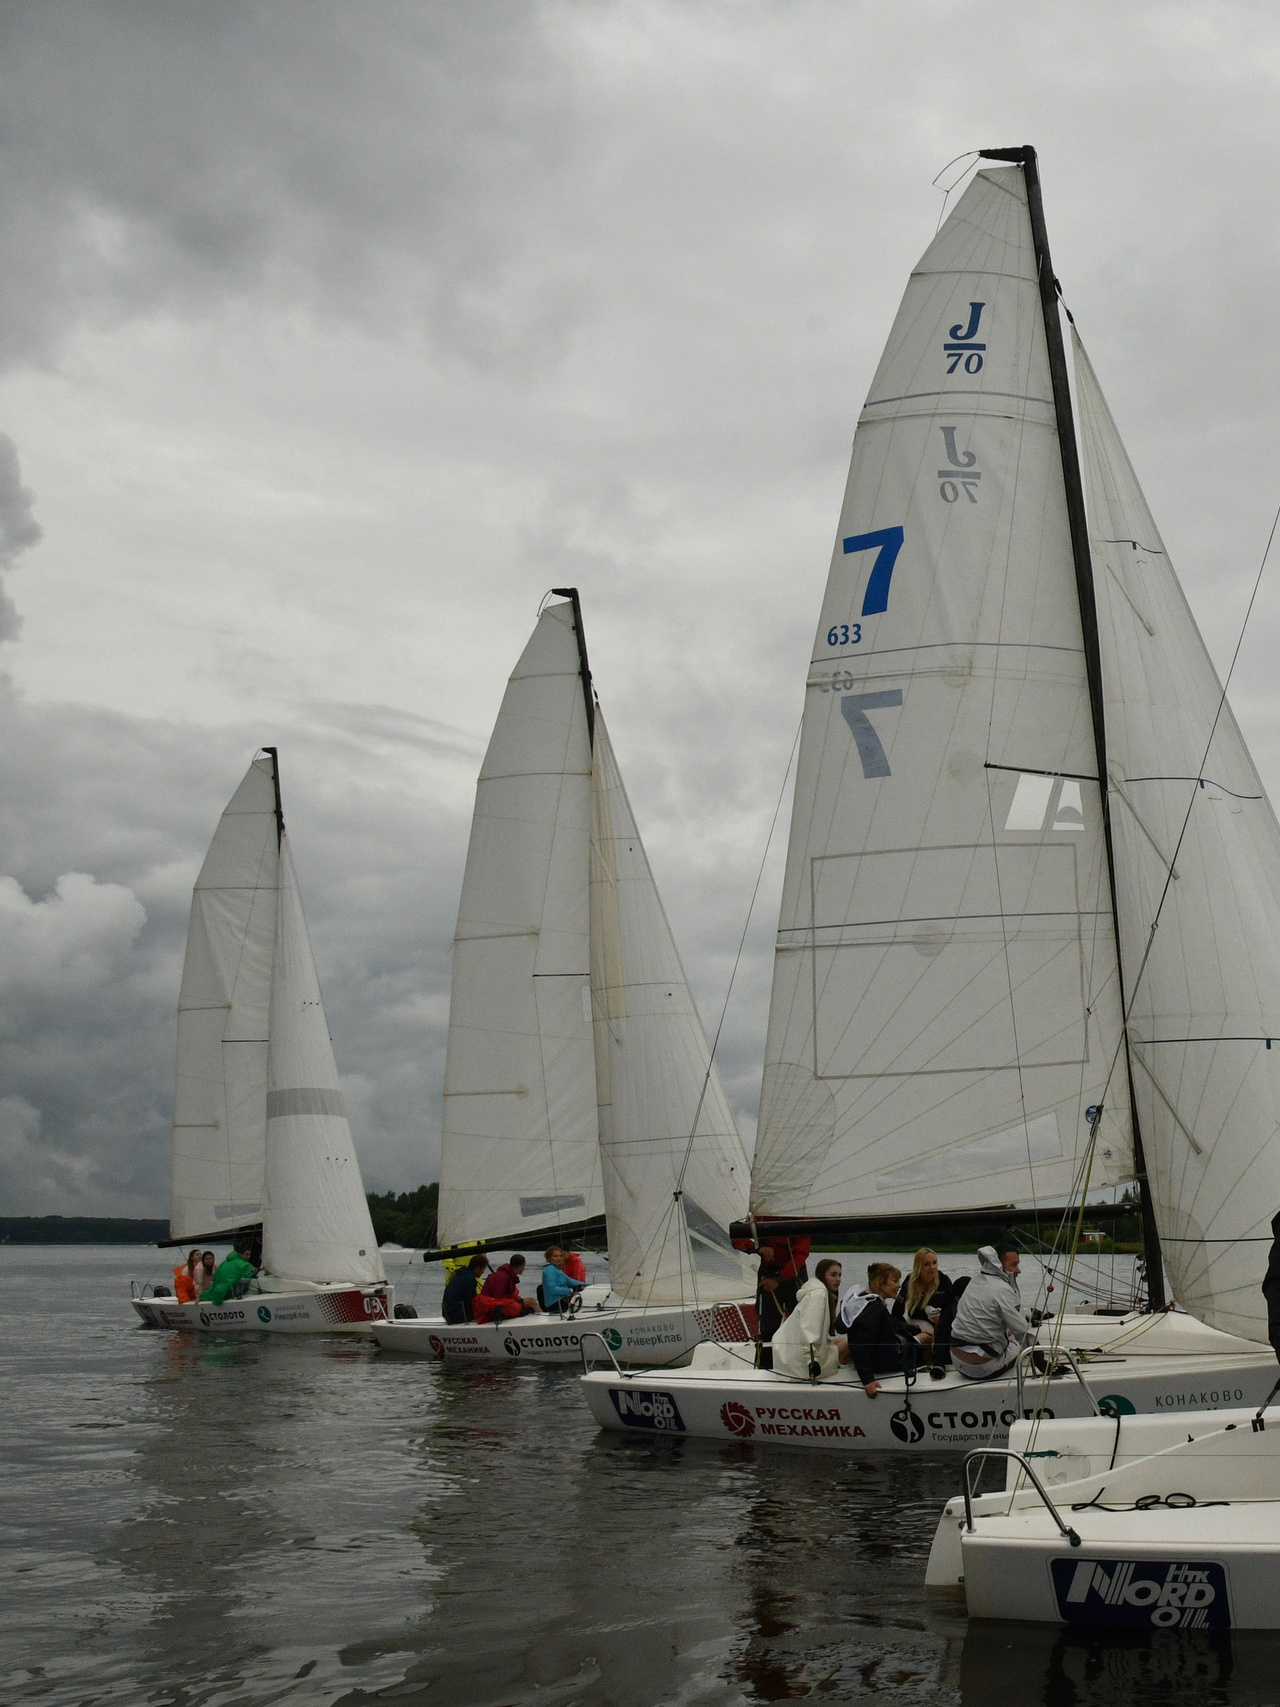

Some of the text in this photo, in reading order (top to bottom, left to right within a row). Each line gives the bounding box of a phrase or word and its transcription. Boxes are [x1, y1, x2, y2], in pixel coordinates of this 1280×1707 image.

[948, 302, 986, 341] J
[946, 352, 984, 375] 70
[842, 526, 905, 617] 7
[827, 623, 862, 646] 633
[209, 1310, 245, 1321] СТОЛОТО
[629, 1323, 675, 1335] КОНАКОВО
[442, 1336, 479, 1345] РУССКАЯ
[519, 1335, 580, 1349] СТОЛОТО
[626, 1333, 683, 1347] РиверКлаб
[445, 1346, 491, 1355] МЕХАНИКА
[1155, 1388, 1243, 1407] КОНАКОВО
[755, 1407, 841, 1421] РУССКАЯ
[653, 1416, 679, 1431] OIL
[760, 1423, 866, 1438] МЕХАНИКА
[932, 1432, 1010, 1443] Государственны
